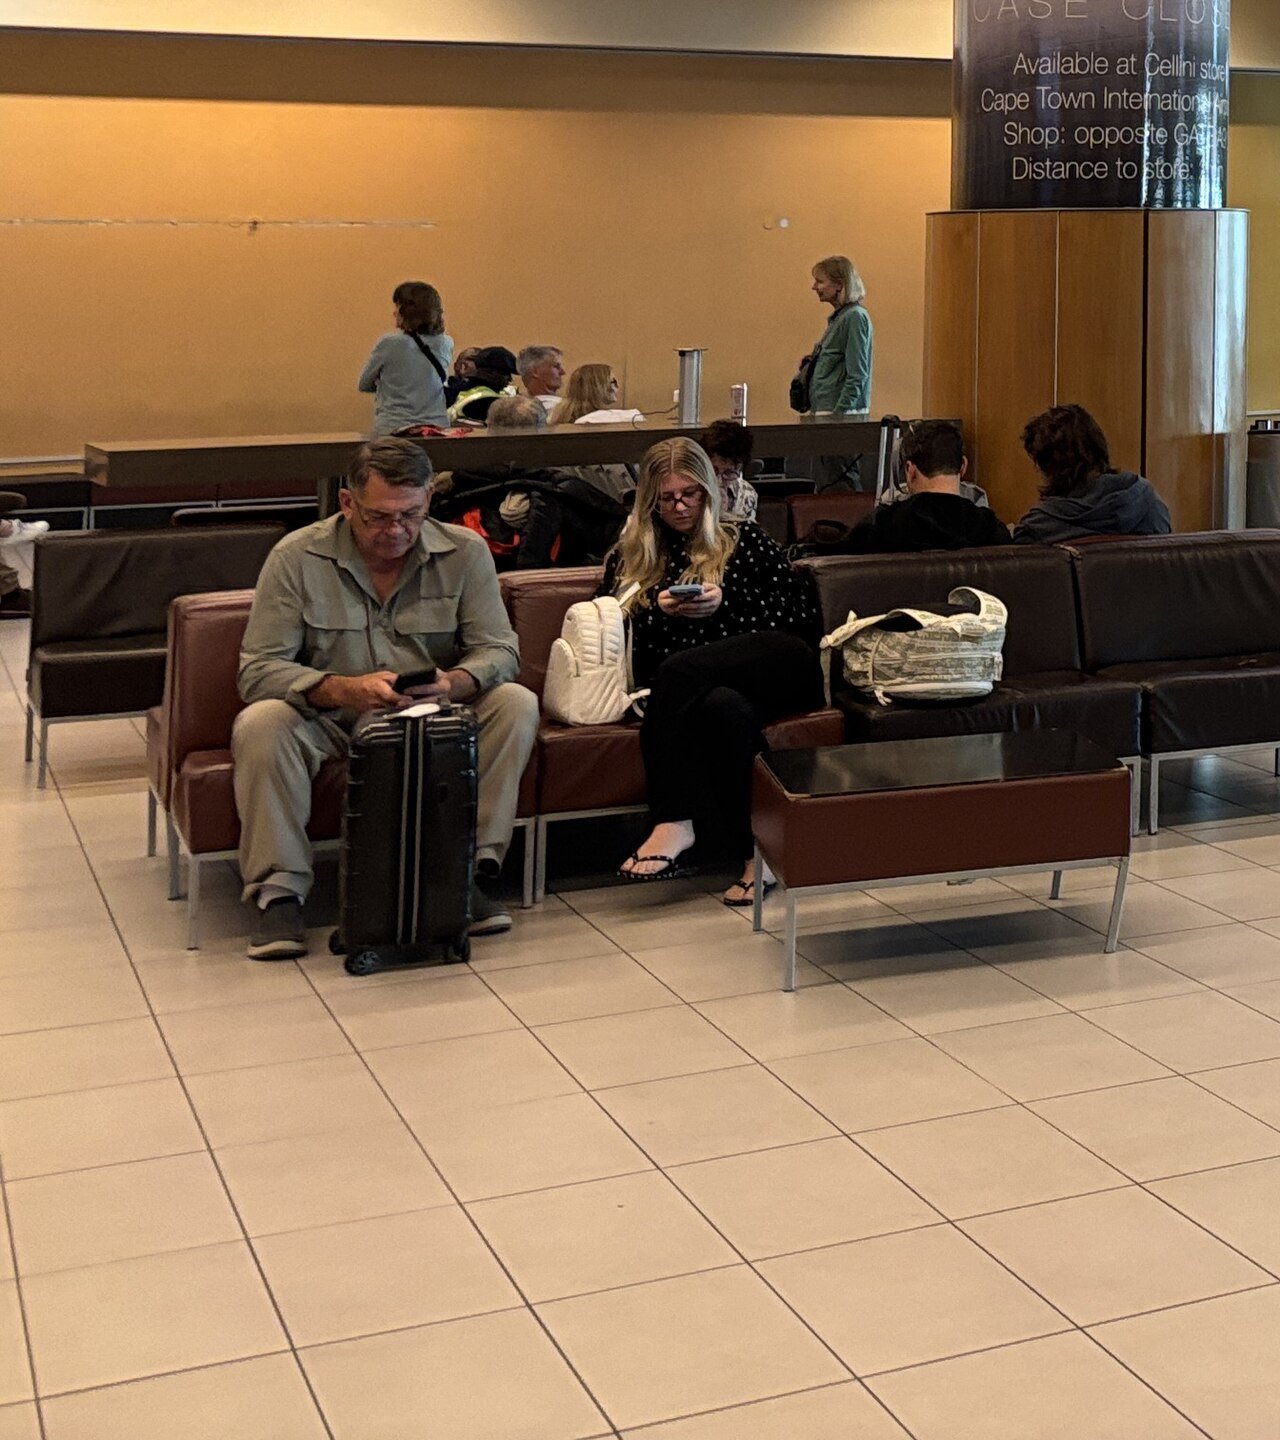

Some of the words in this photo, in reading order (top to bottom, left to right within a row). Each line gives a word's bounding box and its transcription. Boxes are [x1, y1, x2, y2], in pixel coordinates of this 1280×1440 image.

[1013, 52, 1109, 75] Available
[1116, 54, 1138, 76] at
[1144, 52, 1196, 78] Cellini
[981, 88, 1030, 115] Cape
[1036, 86, 1095, 110] Town
[1104, 86, 1211, 113] Internationl
[1003, 121, 1066, 149] Shop:
[1074, 124, 1168, 150] opposte
[1013, 157, 1108, 180] Distance
[1116, 158, 1138, 180] to
